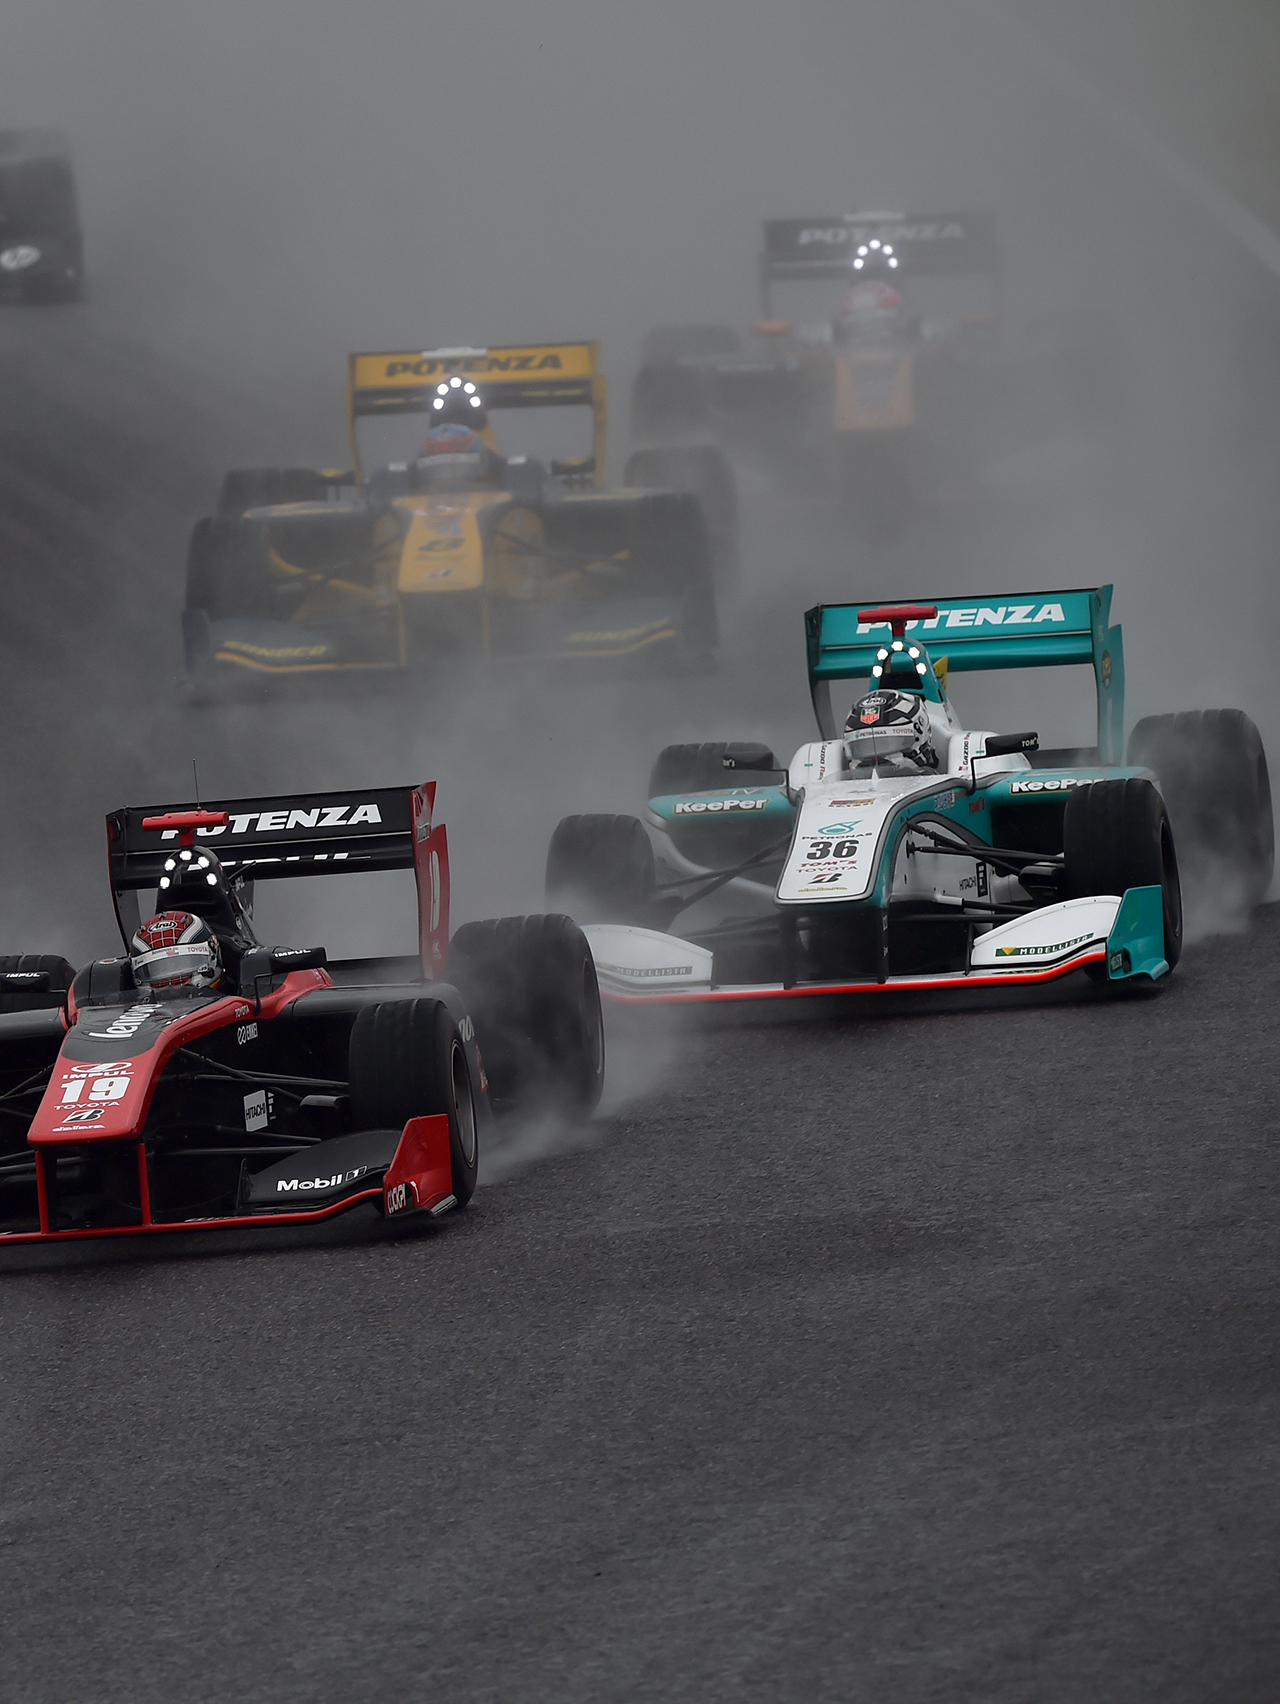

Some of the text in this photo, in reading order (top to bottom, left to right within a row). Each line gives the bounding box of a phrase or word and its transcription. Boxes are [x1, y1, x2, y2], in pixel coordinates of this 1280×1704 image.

[856, 603, 1066, 635] TENZA
[675, 799, 768, 814] KeePer
[160, 803, 383, 841] TENZA
[802, 832, 873, 840] PETRONAS
[806, 840, 860, 860] 36
[275, 948, 312, 958] IMPUL
[1020, 935, 1090, 956] MODELLISTA
[62, 1070, 135, 1080] IMPUL
[60, 1076, 131, 1104] 19
[53, 1101, 120, 1111] TOYOTA
[245, 1102, 266, 1120] HITACHI
[276, 1173, 343, 1192] Mobil
